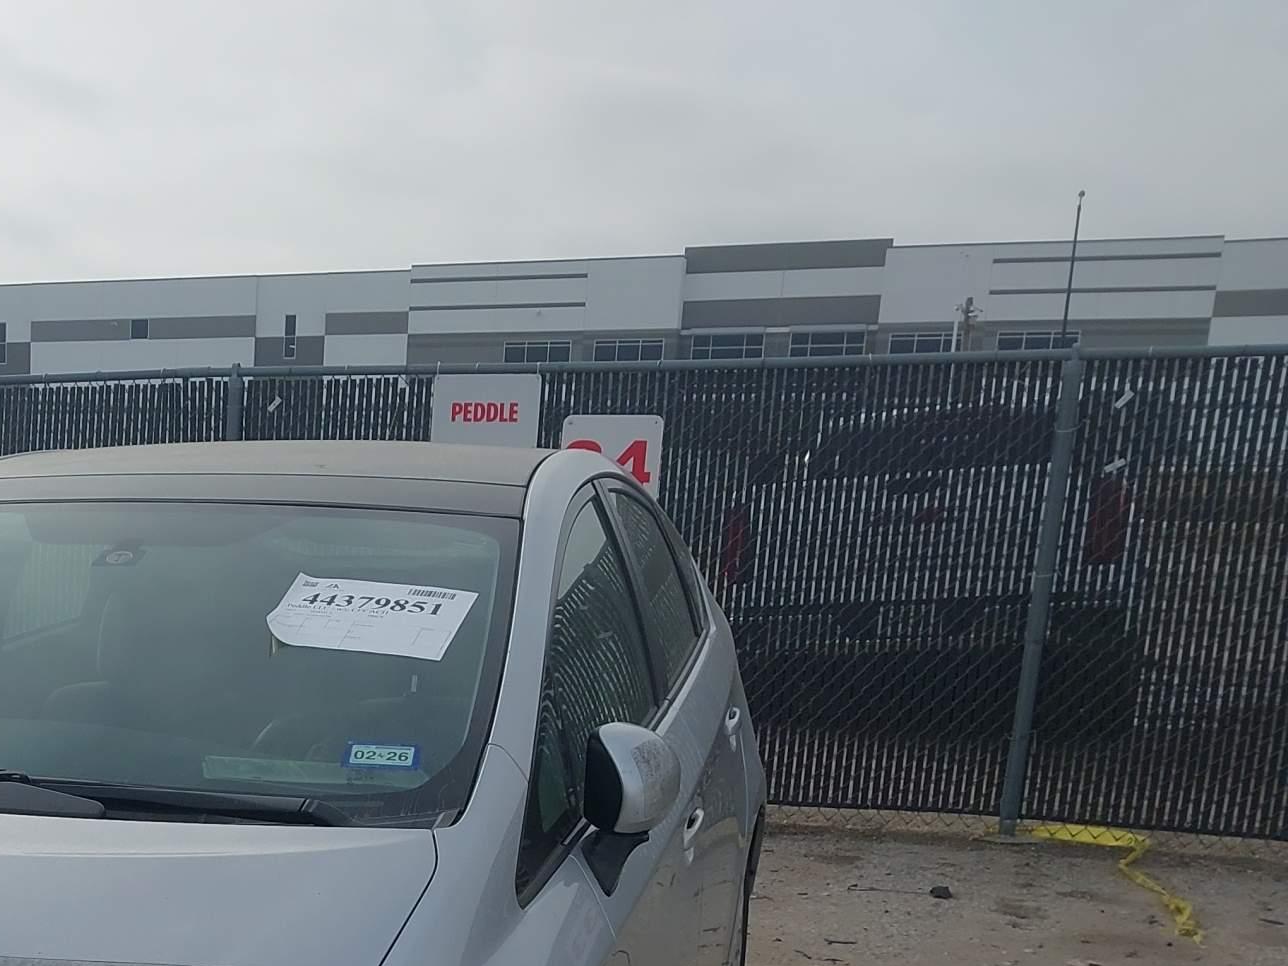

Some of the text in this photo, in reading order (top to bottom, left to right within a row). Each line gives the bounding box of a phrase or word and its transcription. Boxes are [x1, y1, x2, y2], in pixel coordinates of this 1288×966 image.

[451, 402, 519, 422] PEDDLE
[567, 439, 652, 485] 4
[302, 592, 443, 615] 44379851
[354, 750, 409, 761] 02 26
